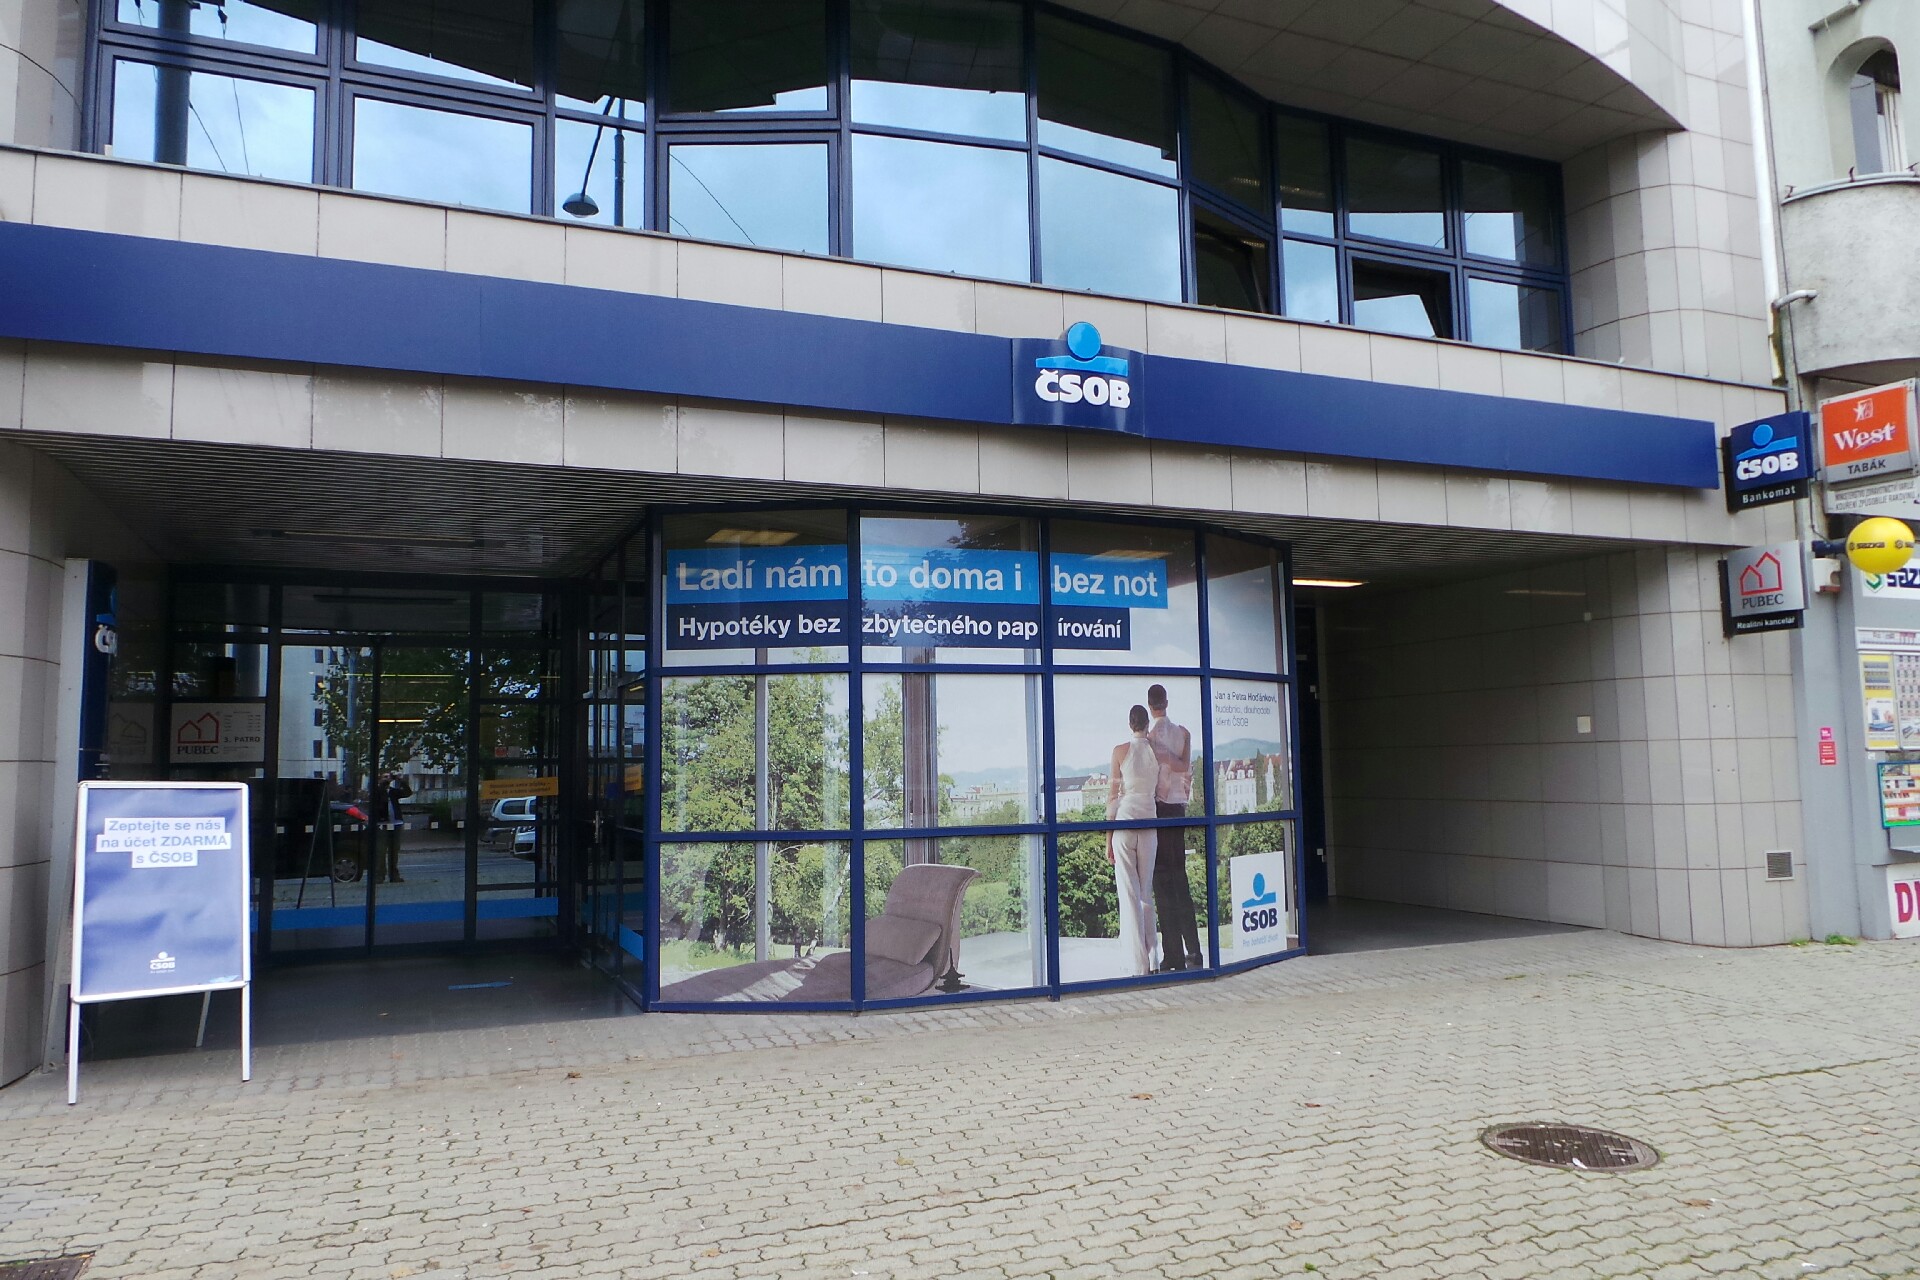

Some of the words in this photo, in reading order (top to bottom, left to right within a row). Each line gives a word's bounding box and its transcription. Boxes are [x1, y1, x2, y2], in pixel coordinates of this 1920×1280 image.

[1035, 369, 1131, 409] ČSOB
[1833, 422, 1896, 450] West
[1736, 452, 1799, 480] ČSOB
[1848, 459, 1886, 474] TABÁK
[1742, 485, 1796, 504] Bankomat
[679, 559, 756, 591] Ladí
[766, 558, 841, 589] nám
[863, 559, 898, 588] to
[909, 560, 1004, 591] doma
[1014, 563, 1022, 591] i
[1054, 564, 1105, 595] bez
[1114, 571, 1158, 597] not
[1742, 593, 1785, 609] PUBEC
[679, 614, 791, 641] Hypotéky
[798, 614, 841, 634] bez
[862, 614, 993, 638] zbytečného
[1215, 691, 1225, 699] Jan
[177, 745, 220, 755] PUBEC
[109, 820, 170, 833] Zeptejte
[174, 821, 191, 831] se
[195, 819, 221, 831] nás
[101, 838, 119, 848] na
[124, 836, 157, 848] účet
[160, 835, 228, 847] ZDARMA
[136, 854, 144, 864] s
[149, 850, 194, 864] ČSOB
[1242, 908, 1277, 933] ČSOB
